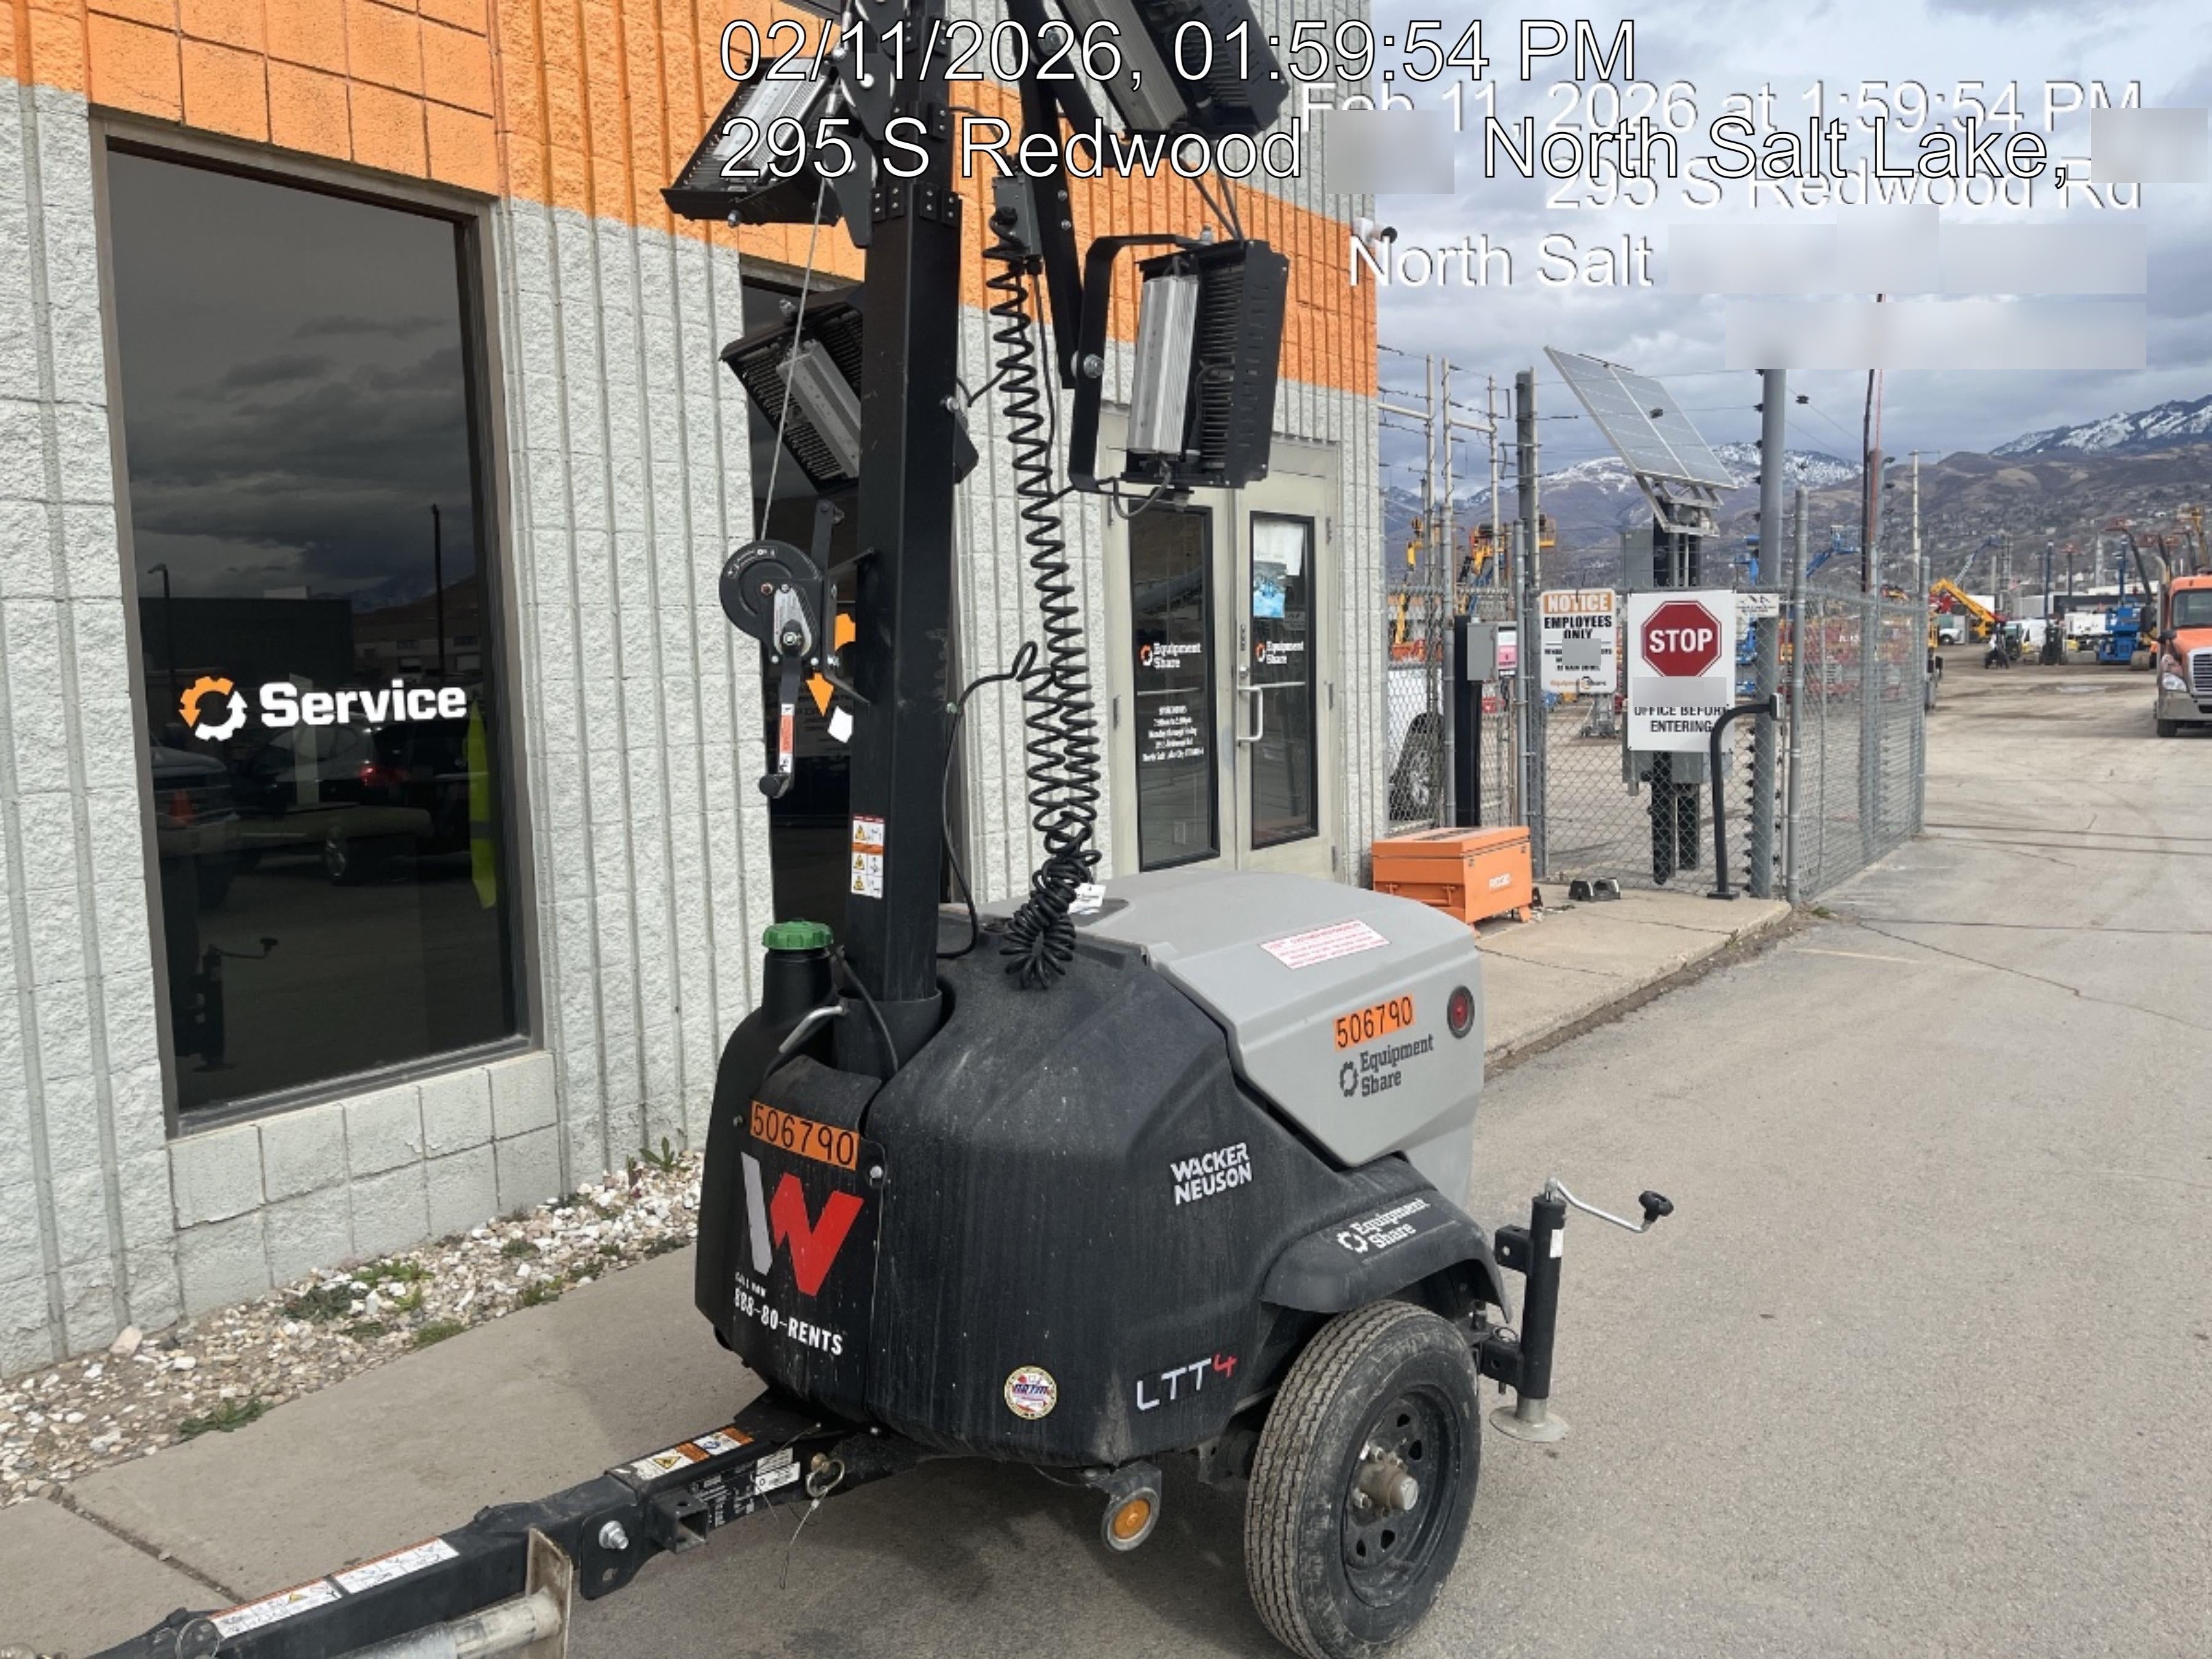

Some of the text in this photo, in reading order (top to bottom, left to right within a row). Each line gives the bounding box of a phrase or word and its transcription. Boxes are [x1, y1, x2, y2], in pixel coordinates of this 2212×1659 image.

[1543, 615, 1612, 629] EMPLOYEES
[1547, 593, 1609, 613] NOTICE
[1563, 629, 1593, 638] ONLY
[1649, 627, 1714, 653] STOP
[259, 678, 467, 728] Service
[1650, 720, 1713, 732] ENTERING
[1336, 995, 1413, 1048] 506790
[1360, 1033, 1435, 1073] Equipment
[1361, 1070, 1402, 1097] Share
[753, 1105, 854, 1166] 506790
[1170, 1142, 1250, 1183] WACKER
[1174, 1162, 1252, 1206] NEUSON
[1349, 1198, 1431, 1236] Equipment
[1367, 1223, 1416, 1249] Share
[1137, 1353, 1237, 1411] LTT4
